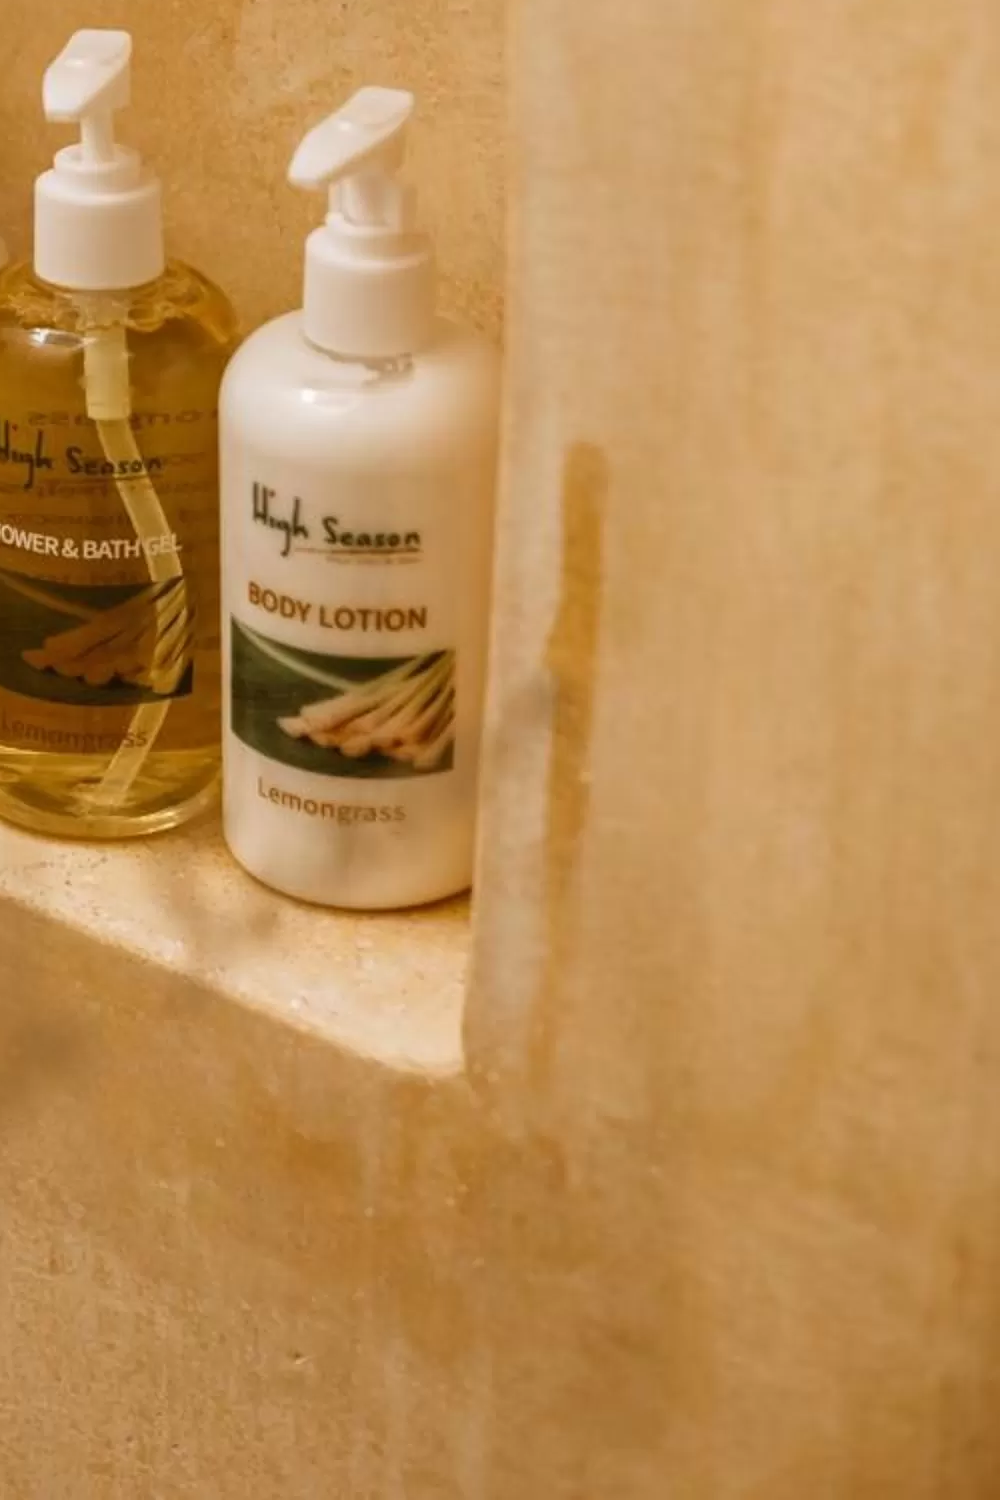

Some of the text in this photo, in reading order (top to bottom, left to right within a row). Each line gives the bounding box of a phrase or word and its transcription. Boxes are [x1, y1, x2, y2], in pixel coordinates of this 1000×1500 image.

[66, 446, 163, 476] Season
[252, 481, 421, 557] High Season
[61, 538, 79, 560] &
[86, 539, 140, 561] BATH
[145, 532, 183, 556] GEL
[248, 581, 428, 633] BODY LOTION
[258, 776, 406, 826] Lemongrass
